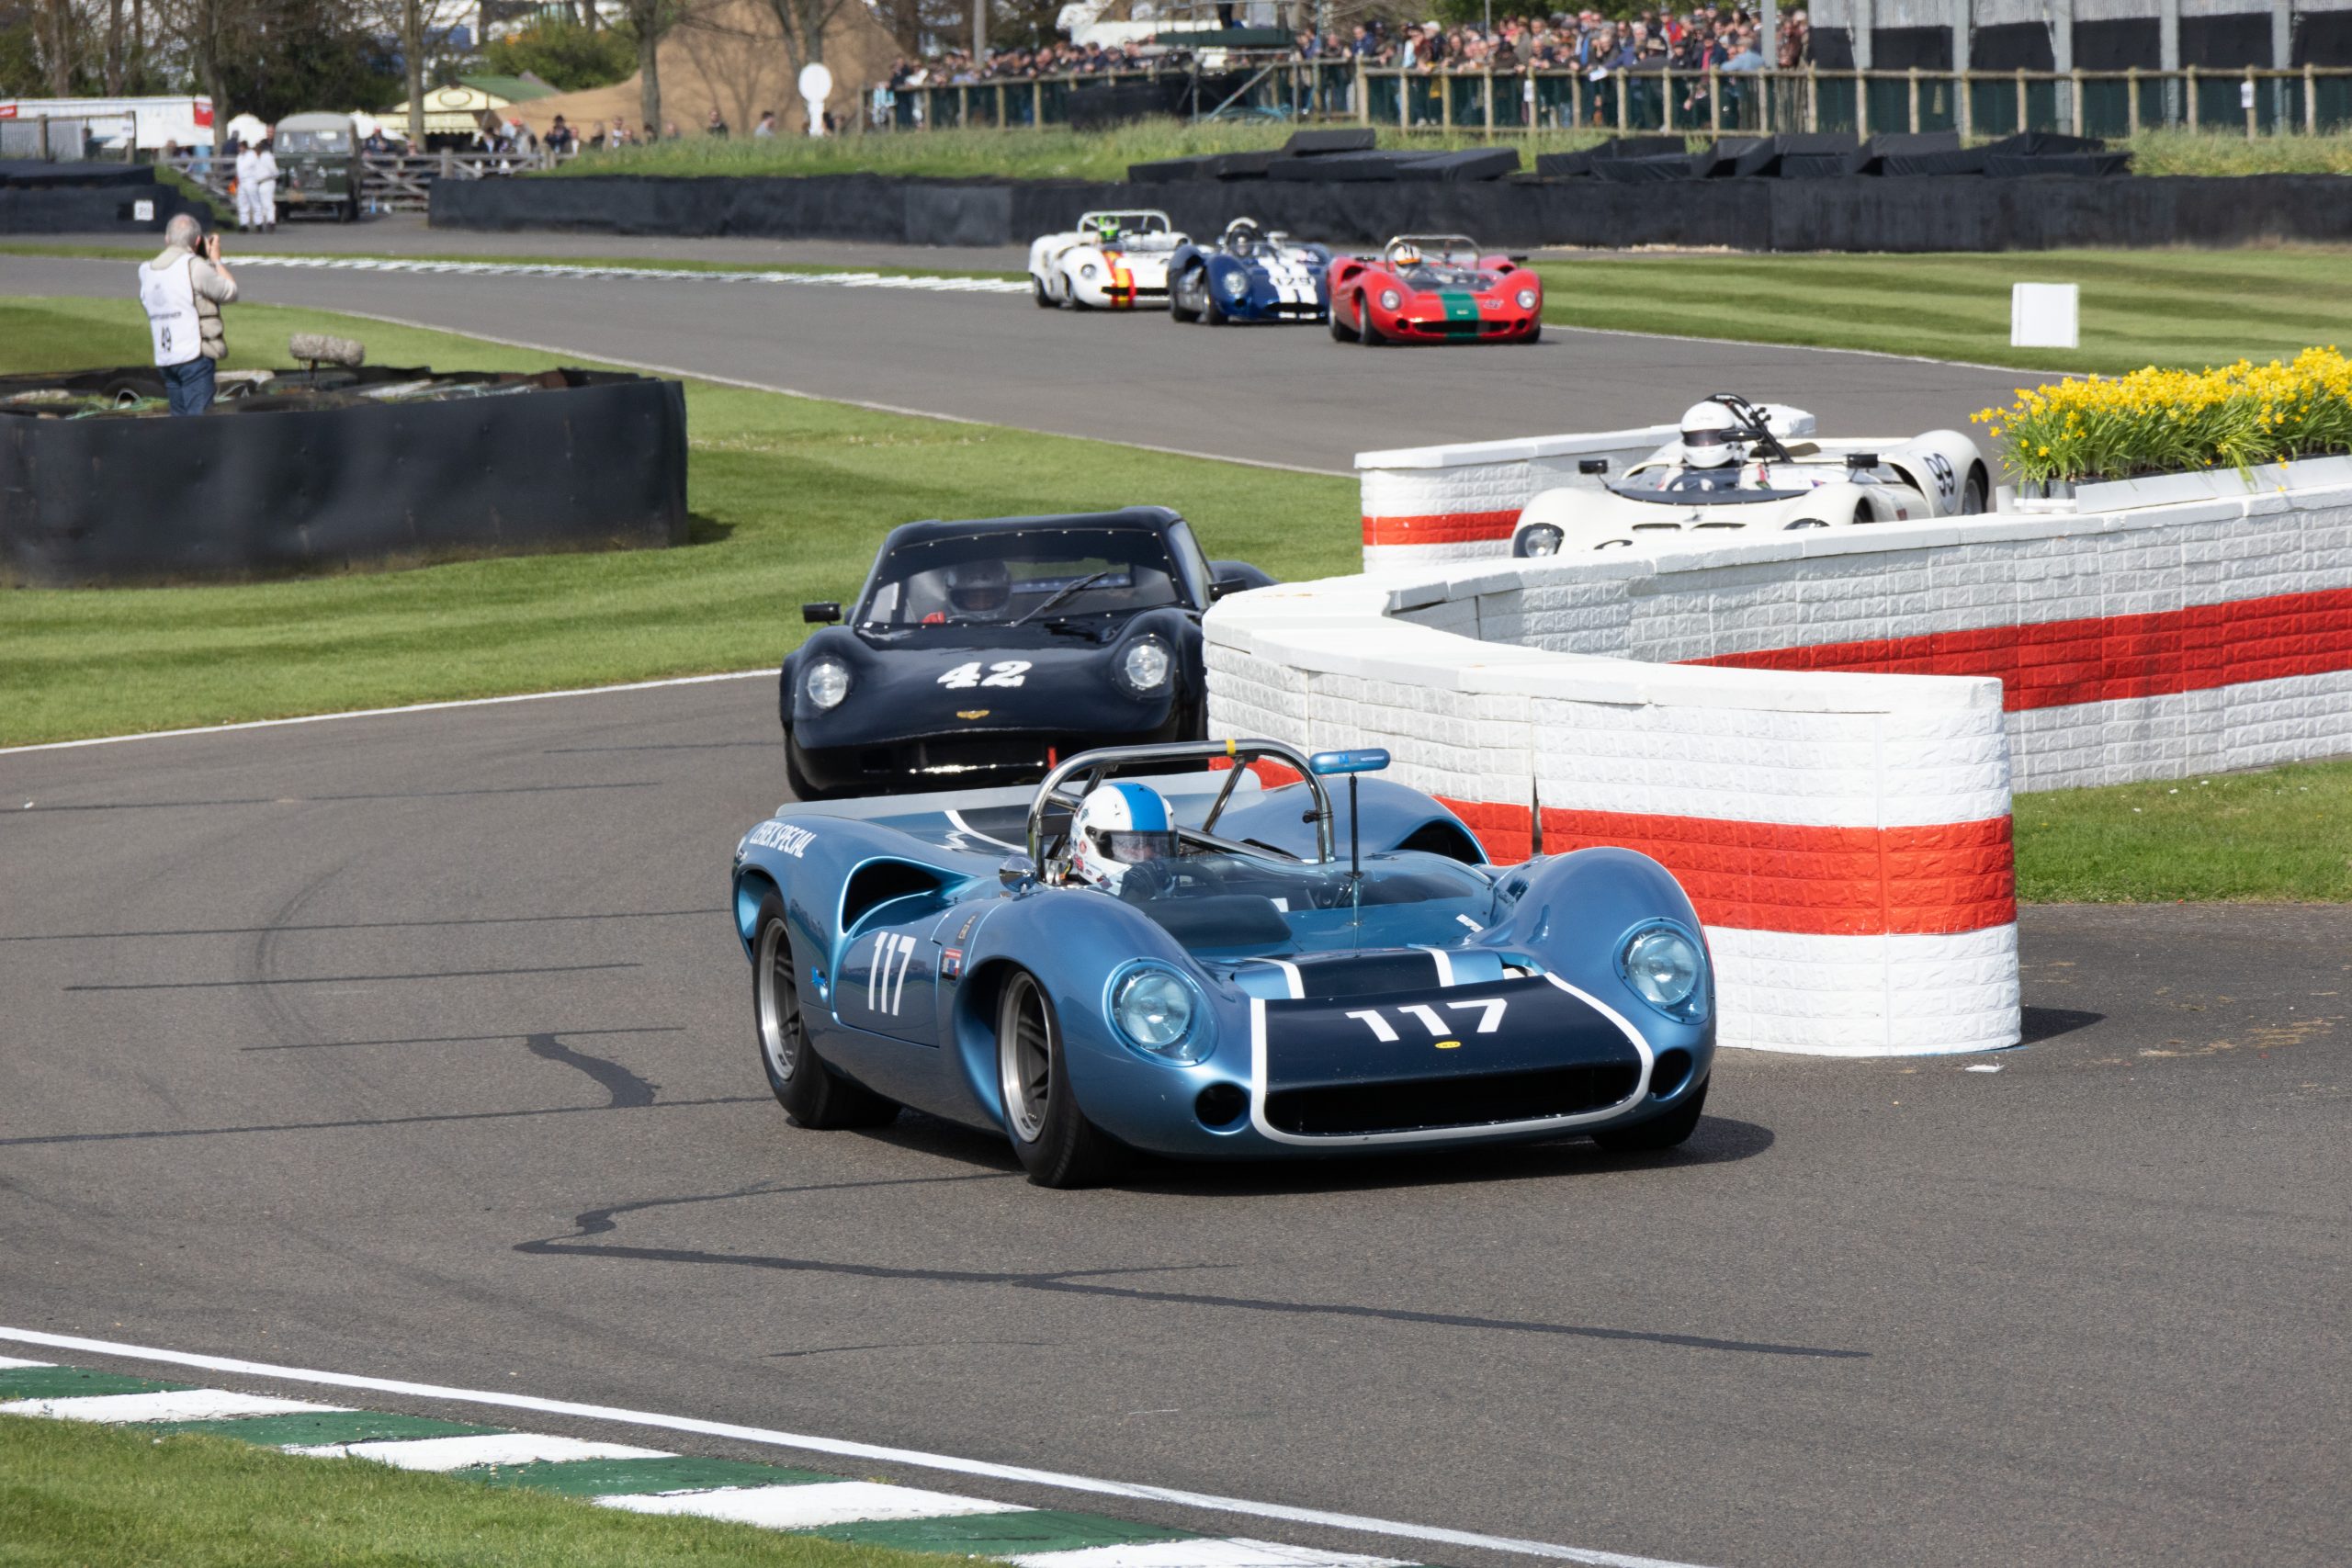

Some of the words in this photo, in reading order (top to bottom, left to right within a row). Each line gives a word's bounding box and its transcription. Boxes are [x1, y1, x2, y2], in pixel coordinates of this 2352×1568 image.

[161, 325, 172, 353] 49
[1923, 453, 1955, 497] 99
[937, 660, 1033, 689] 42
[769, 824, 817, 859] SPECIAL
[868, 931, 917, 1016] 117
[1344, 998, 1508, 1043] 117
